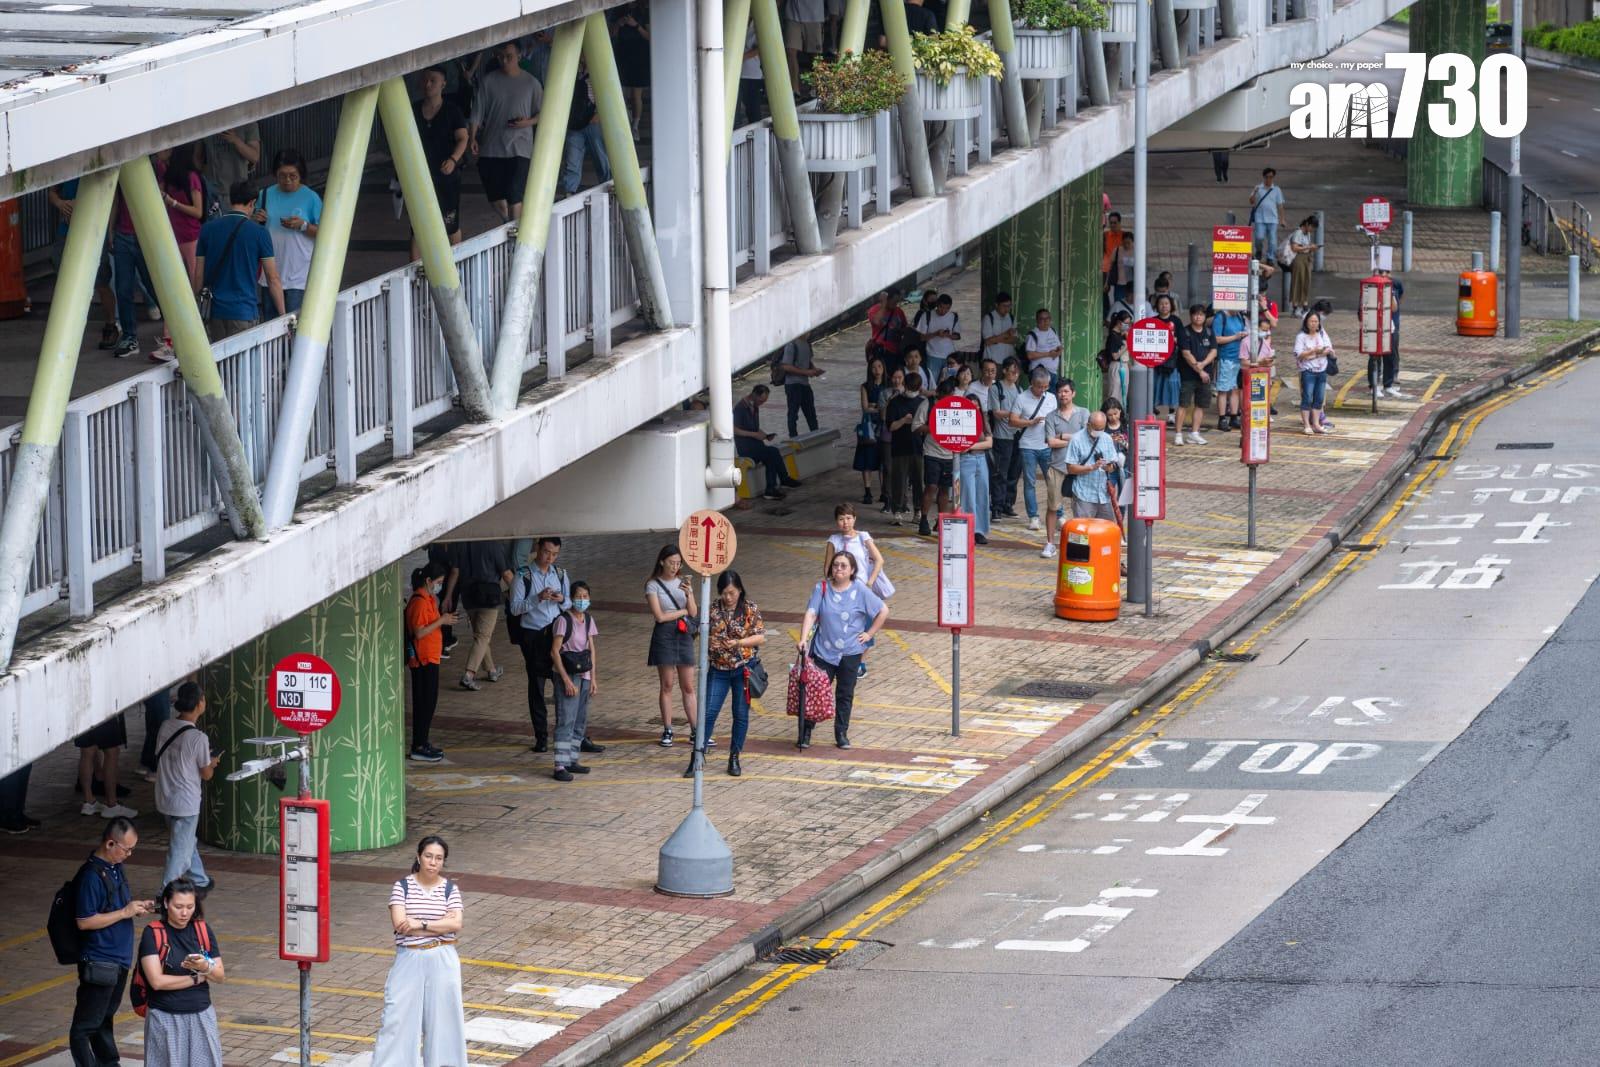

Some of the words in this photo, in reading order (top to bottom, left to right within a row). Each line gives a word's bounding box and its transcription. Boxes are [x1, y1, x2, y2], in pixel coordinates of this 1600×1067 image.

[284, 674, 297, 687] 3D
[309, 676, 327, 689] 11C
[280, 691, 301, 706] N3D
[1115, 740, 1381, 775] STOP
